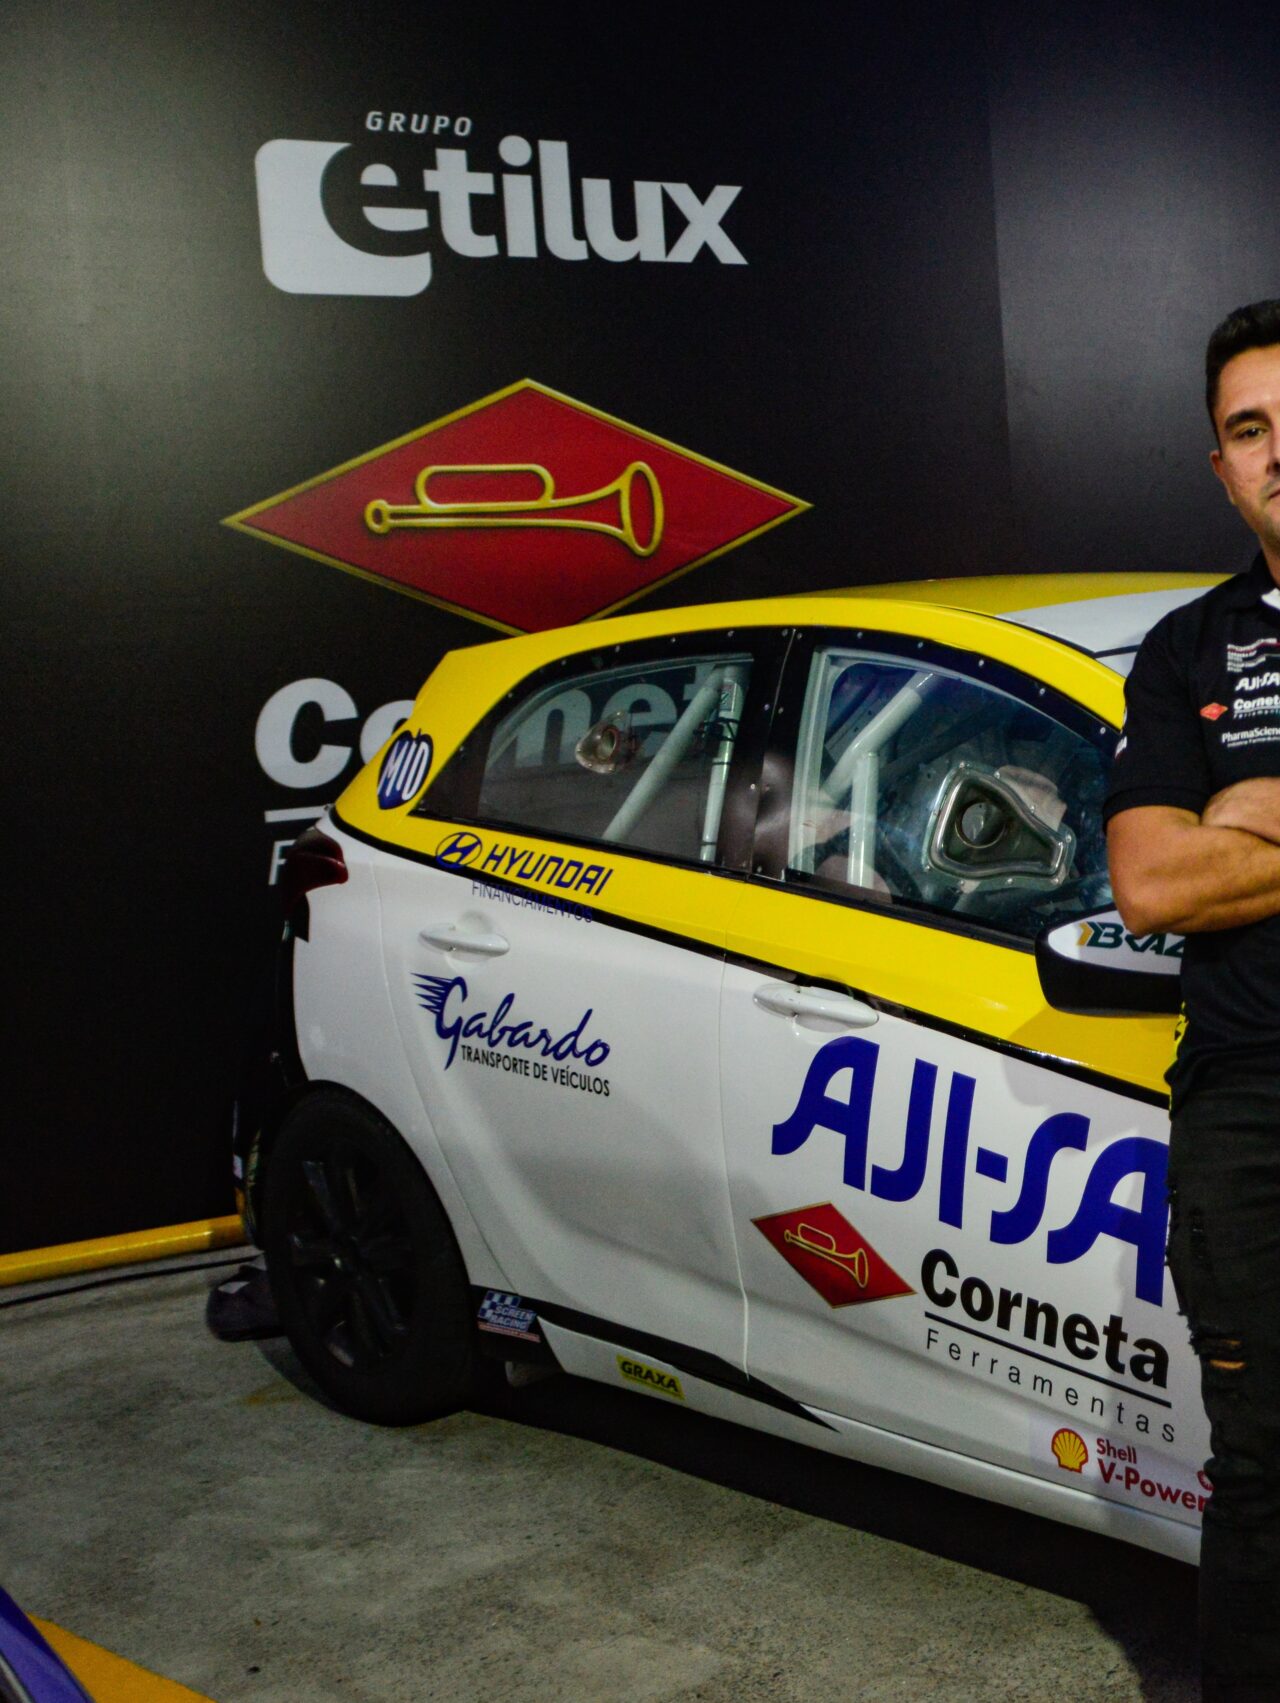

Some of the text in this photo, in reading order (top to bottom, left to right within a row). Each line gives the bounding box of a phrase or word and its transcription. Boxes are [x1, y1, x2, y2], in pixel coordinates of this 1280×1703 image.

[365, 110, 472, 137] GRUPO
[320, 134, 749, 266] etilux
[377, 738, 431, 802] MID
[482, 843, 614, 896] HYUNDAI
[472, 879, 593, 923] FINANCIAMENTOS
[411, 972, 611, 1071] Gabardo
[461, 1045, 610, 1096] TRANSPORTE DE VEÍCULOS
[771, 1035, 1169, 1307] AJI-SA
[921, 1248, 1170, 1389] Corneta
[621, 1361, 679, 1392] GRAXA
[925, 1328, 1175, 1443] Ferramentas
[1096, 1438, 1137, 1464] Shell
